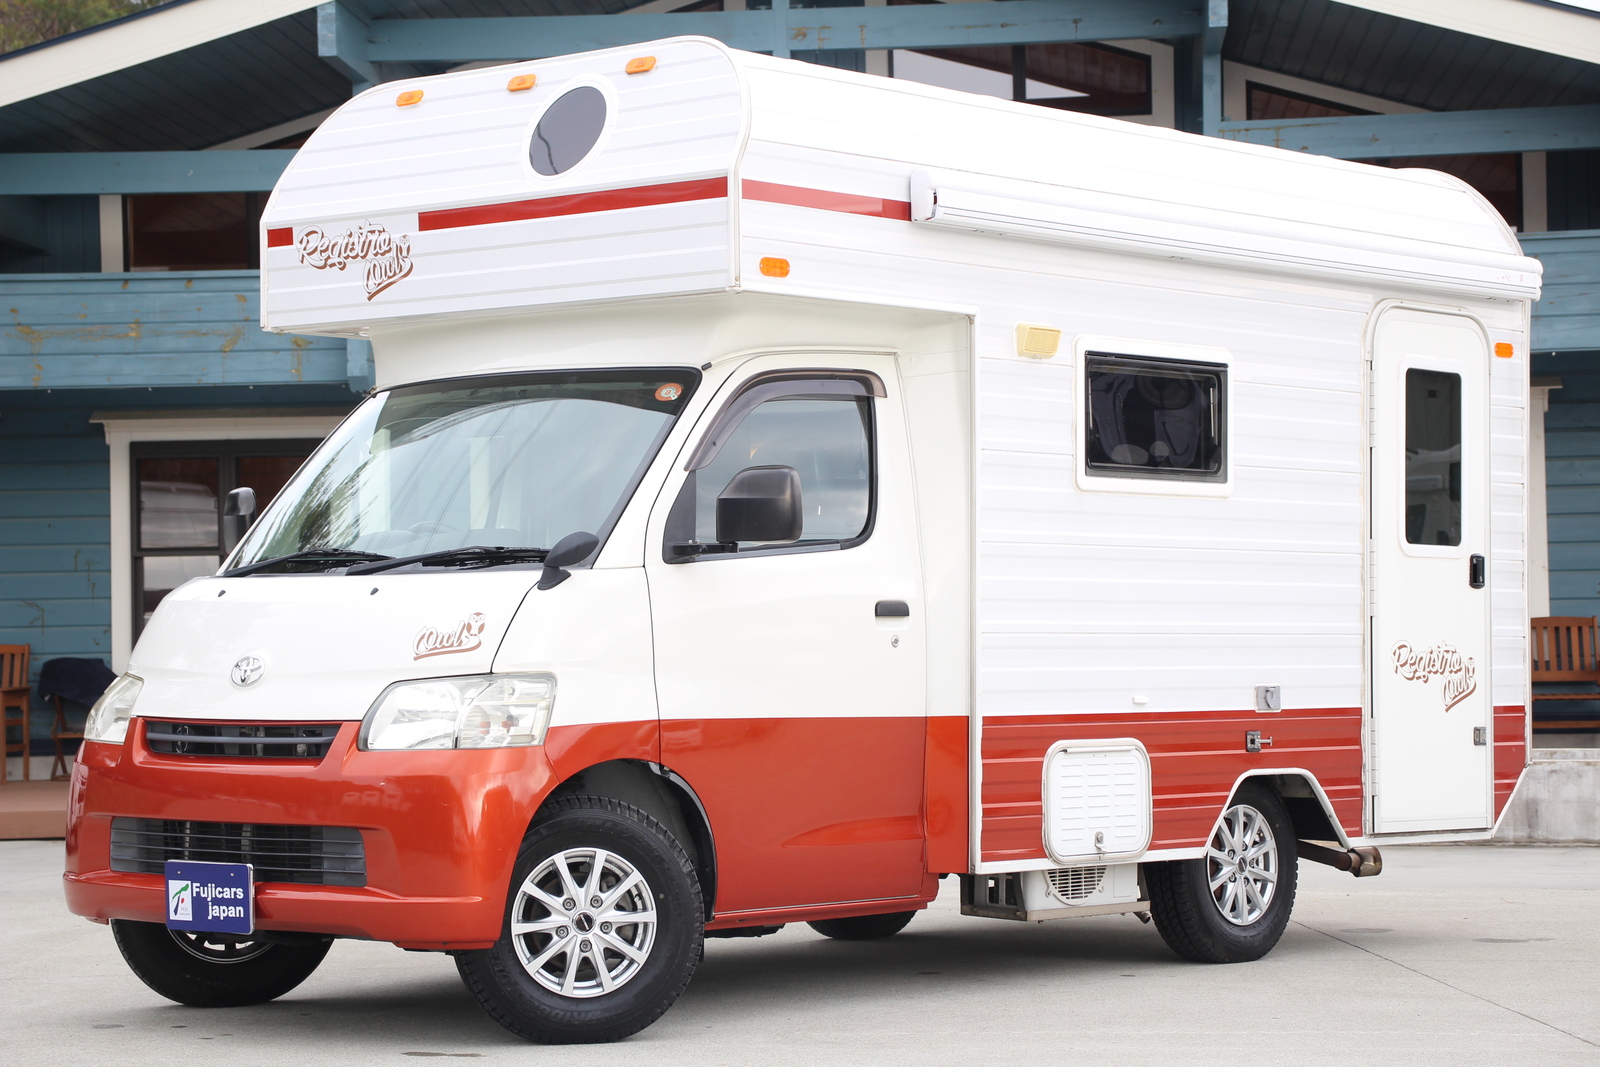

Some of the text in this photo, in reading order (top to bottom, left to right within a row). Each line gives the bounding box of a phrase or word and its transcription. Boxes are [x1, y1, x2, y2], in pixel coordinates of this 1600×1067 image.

[296, 219, 392, 271] Registro
[1391, 640, 1462, 684] Registro
[192, 882, 244, 901] Fujicars
[207, 901, 244, 920] japan
